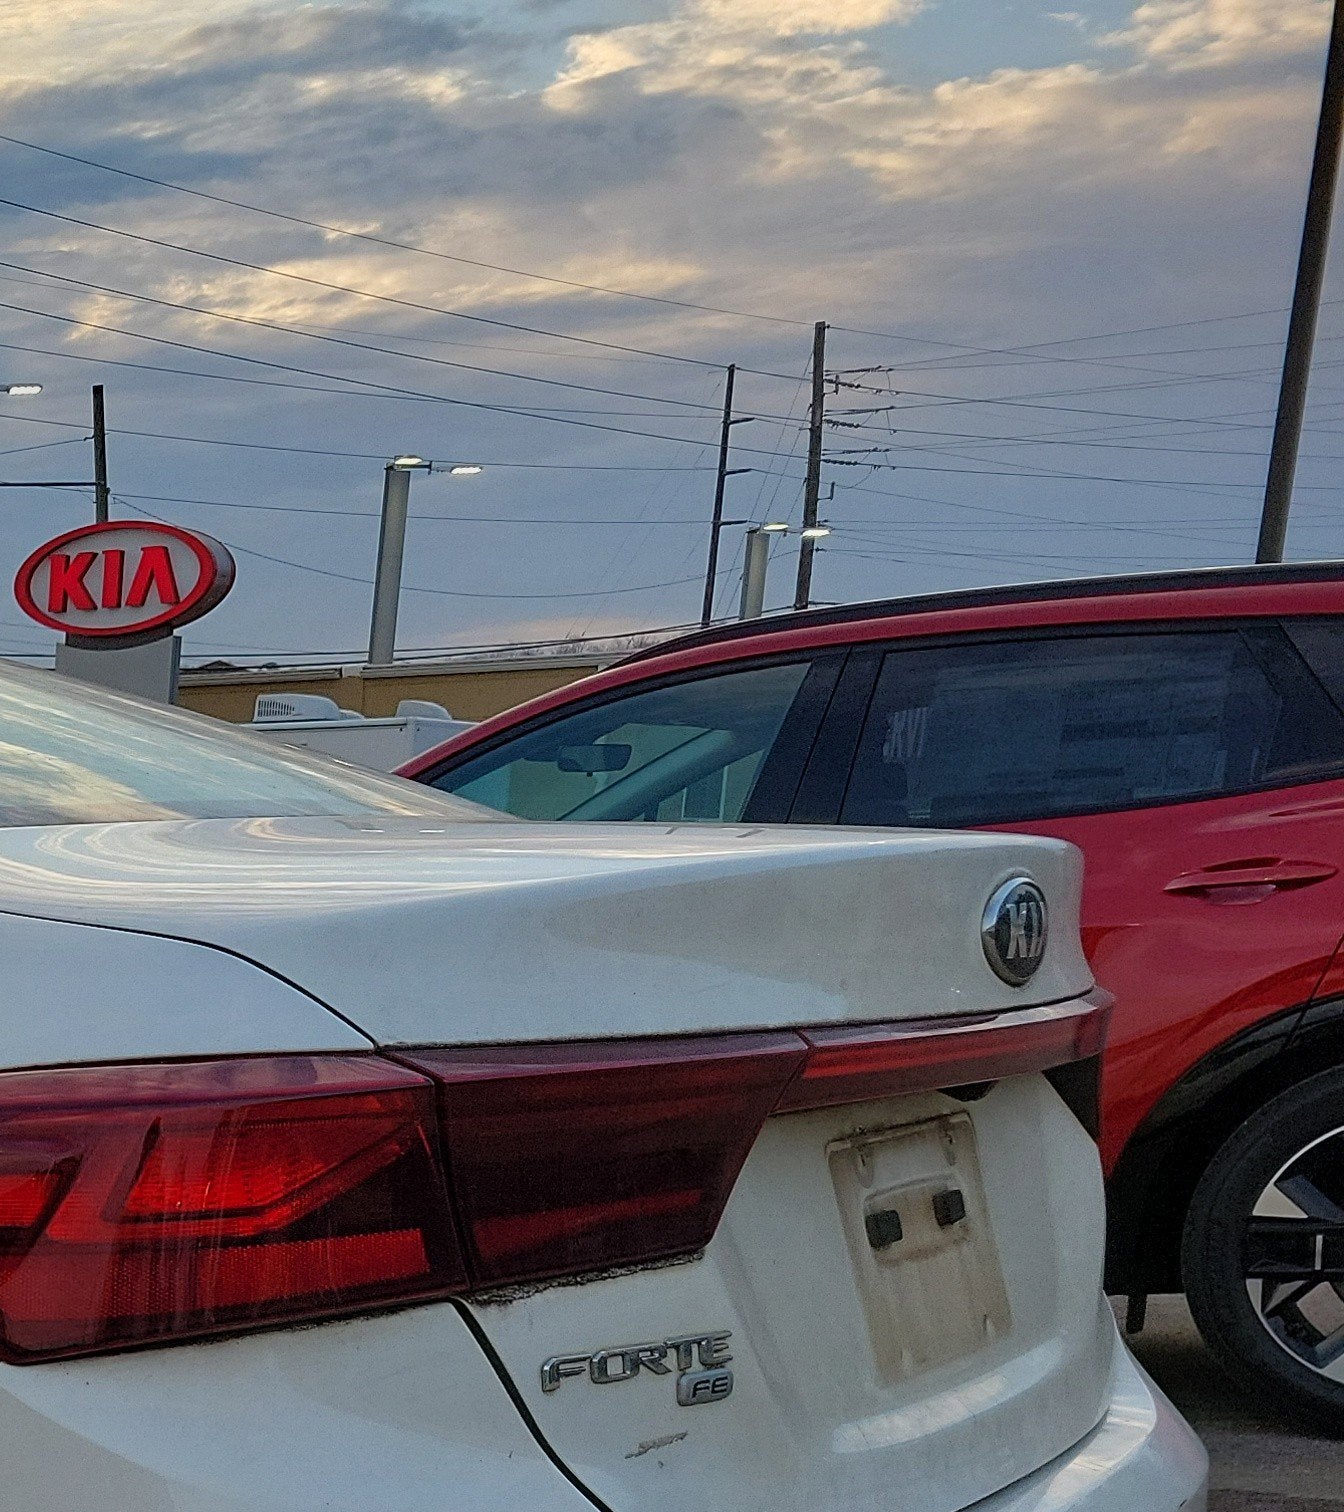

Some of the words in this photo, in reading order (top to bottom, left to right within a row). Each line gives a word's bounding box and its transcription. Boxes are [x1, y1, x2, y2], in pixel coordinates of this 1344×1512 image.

[47, 545, 181, 613] KIA
[541, 1330, 733, 1393] FORTE
[689, 1373, 730, 1400] FE
